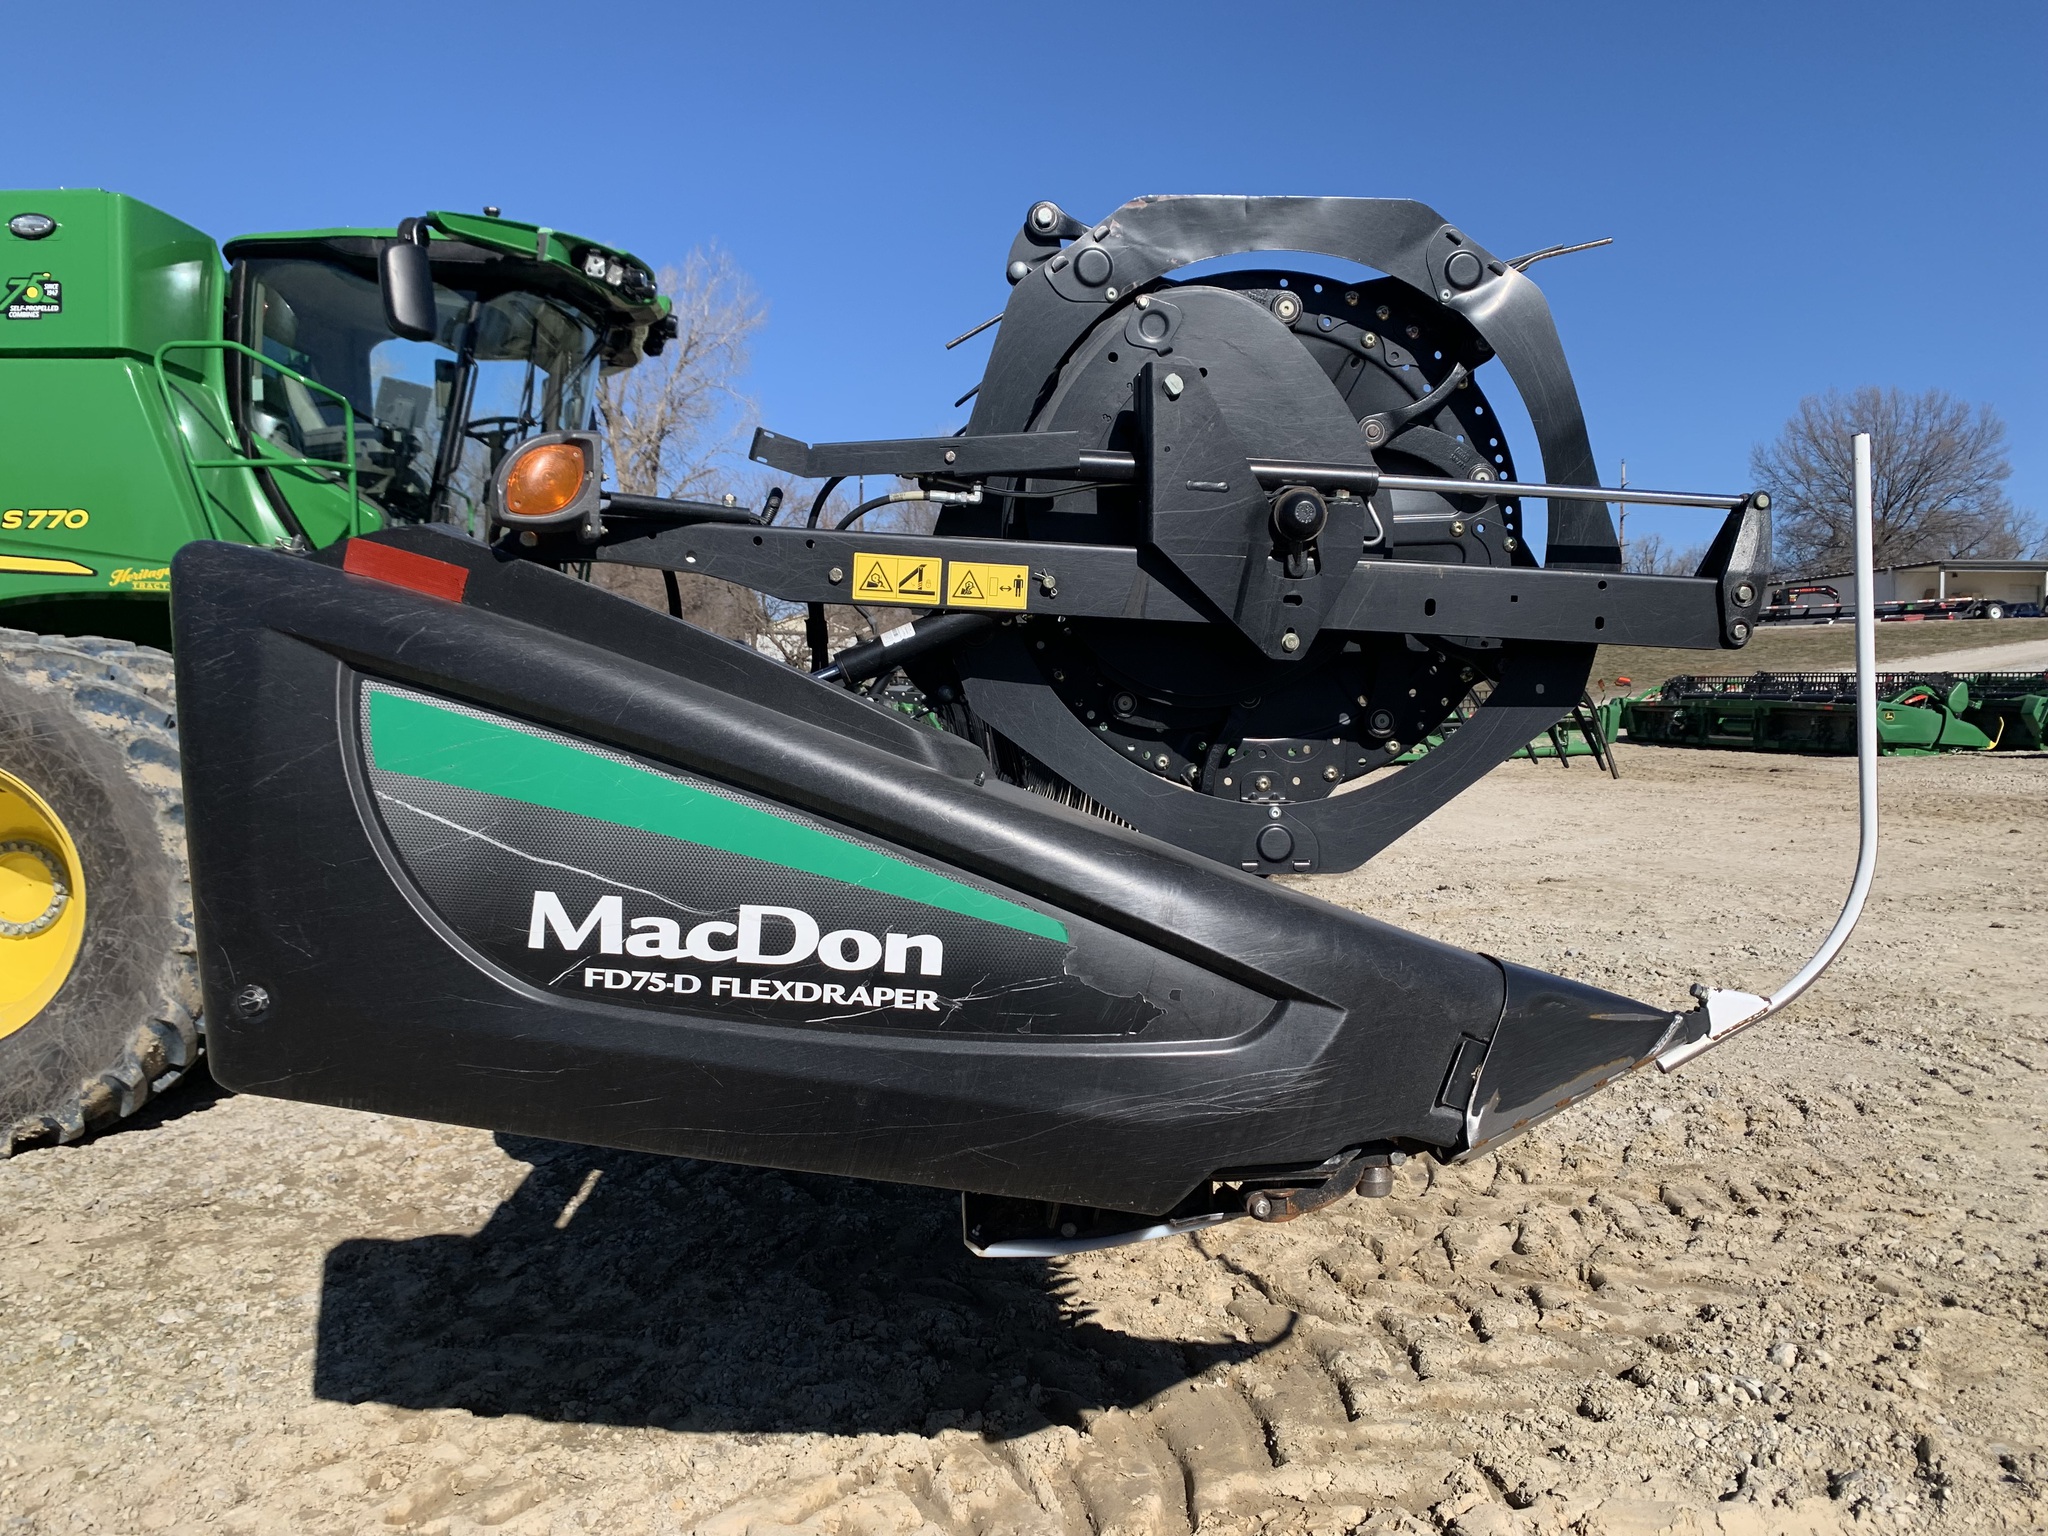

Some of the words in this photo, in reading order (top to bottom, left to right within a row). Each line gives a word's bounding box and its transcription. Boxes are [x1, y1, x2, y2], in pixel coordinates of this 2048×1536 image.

[528, 890, 943, 976] MacDon
[584, 967, 702, 994] FD75-D
[711, 976, 941, 1012] FLEXDRAPER
